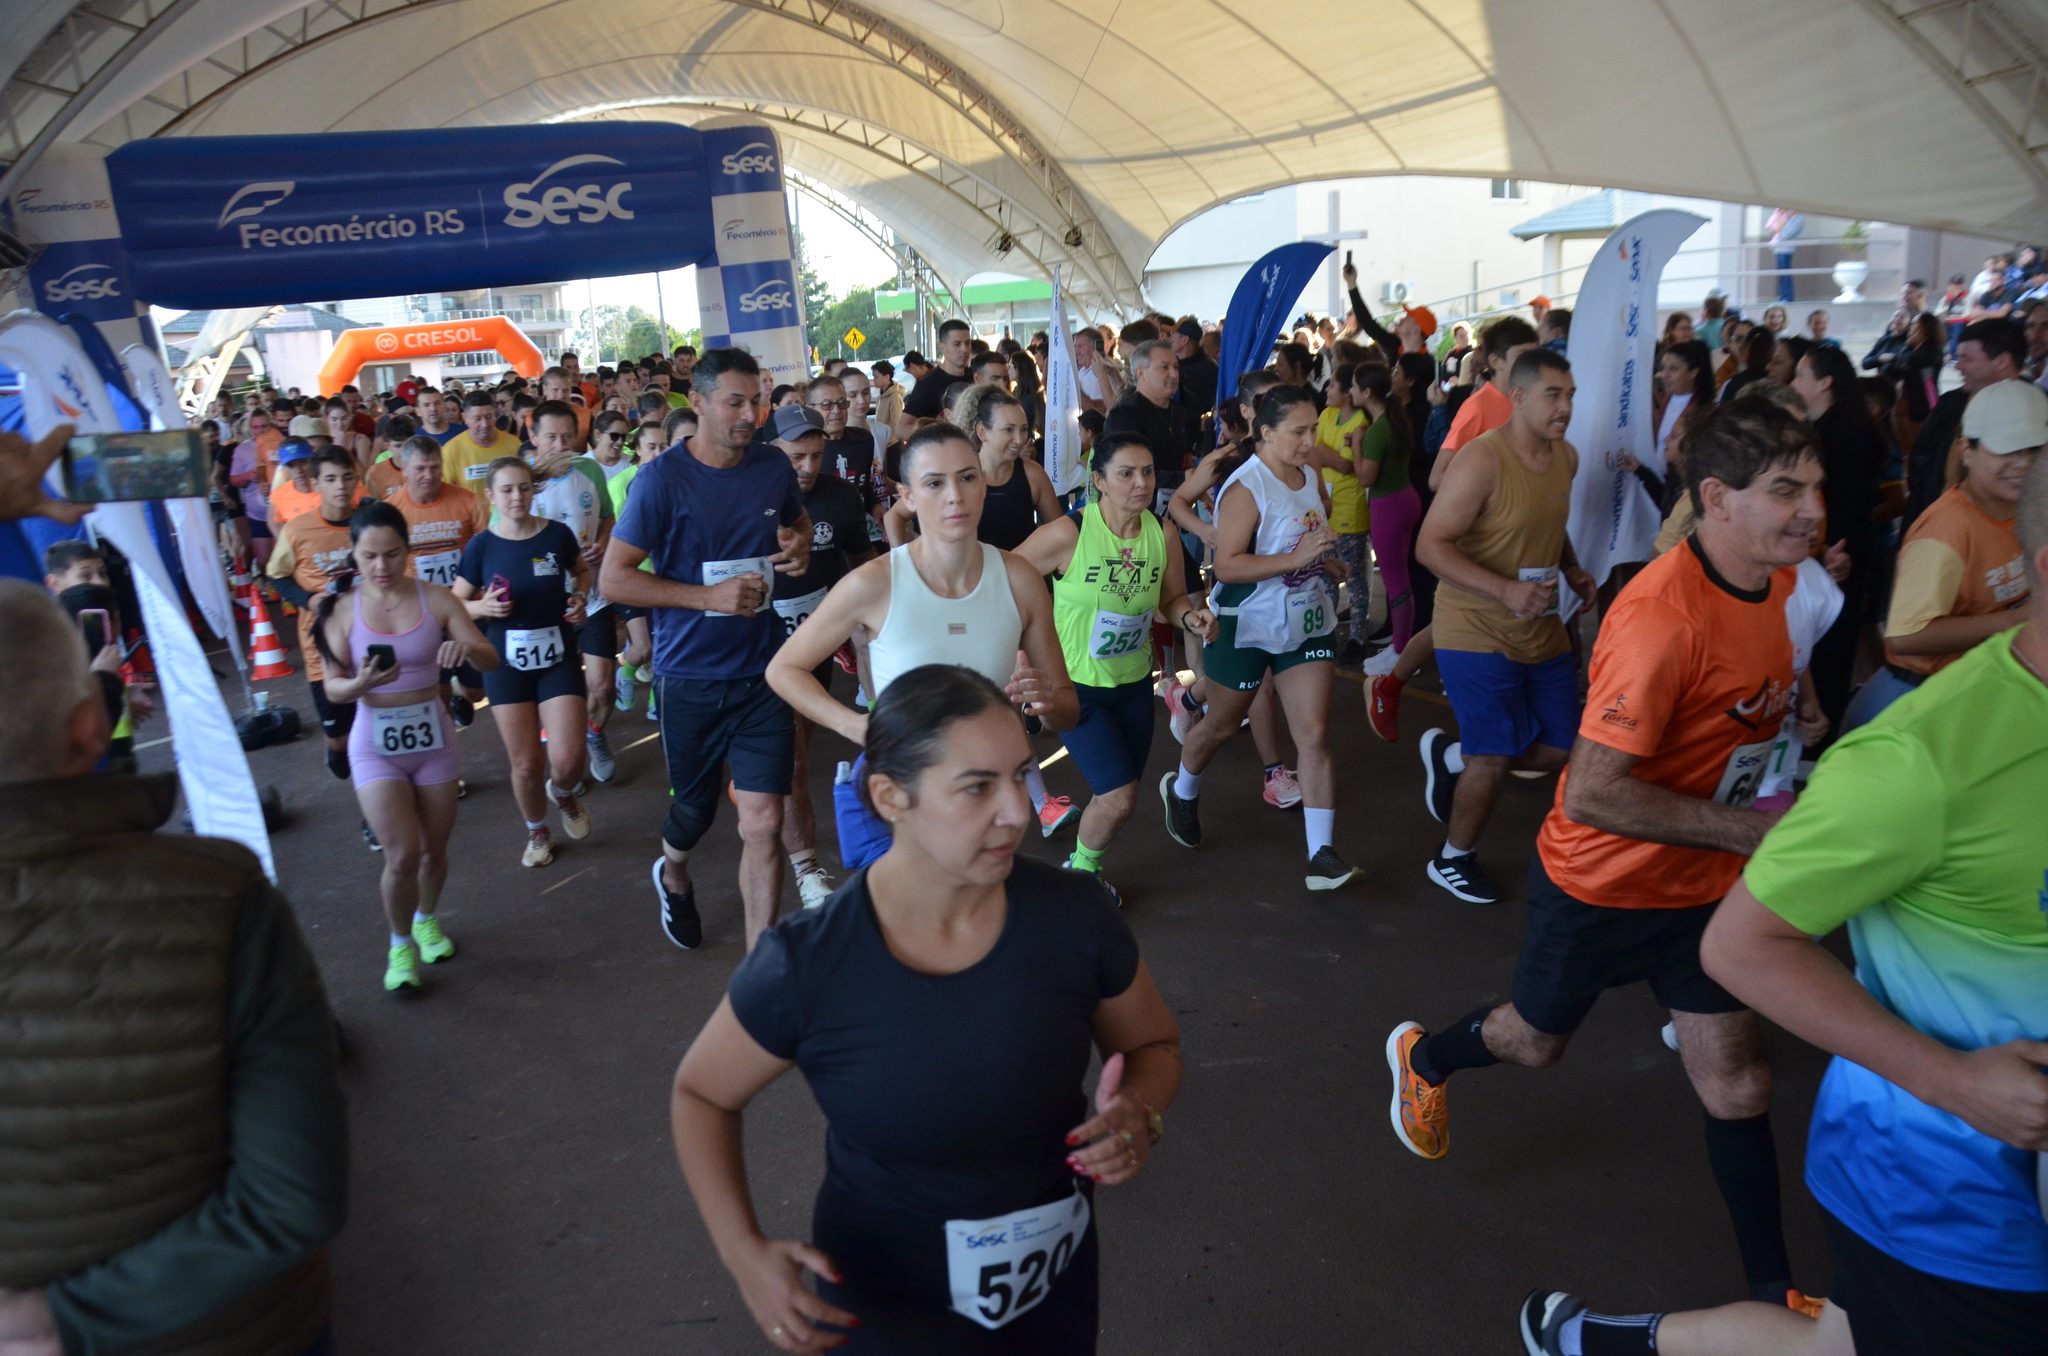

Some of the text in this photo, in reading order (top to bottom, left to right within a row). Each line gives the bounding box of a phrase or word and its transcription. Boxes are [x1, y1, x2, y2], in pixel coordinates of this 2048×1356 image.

[721, 150, 776, 176] Sesc
[503, 166, 635, 229] Sesc
[239, 208, 466, 249] Fecomércio RS
[726, 226, 778, 241] Fecomércio
[44, 270, 122, 302] Sesc
[739, 287, 793, 313] Sesc
[403, 326, 483, 349] CRESOL
[1084, 559, 1161, 584] ELAS
[1100, 584, 1151, 594] CORREM
[1100, 617, 1118, 627] Sesc
[1303, 604, 1325, 635] 89
[515, 642, 560, 668] 514
[1095, 628, 1143, 656] 252
[383, 721, 435, 752] 663
[966, 1230, 1009, 1249] Sesc
[977, 1231, 1075, 1322] 520
